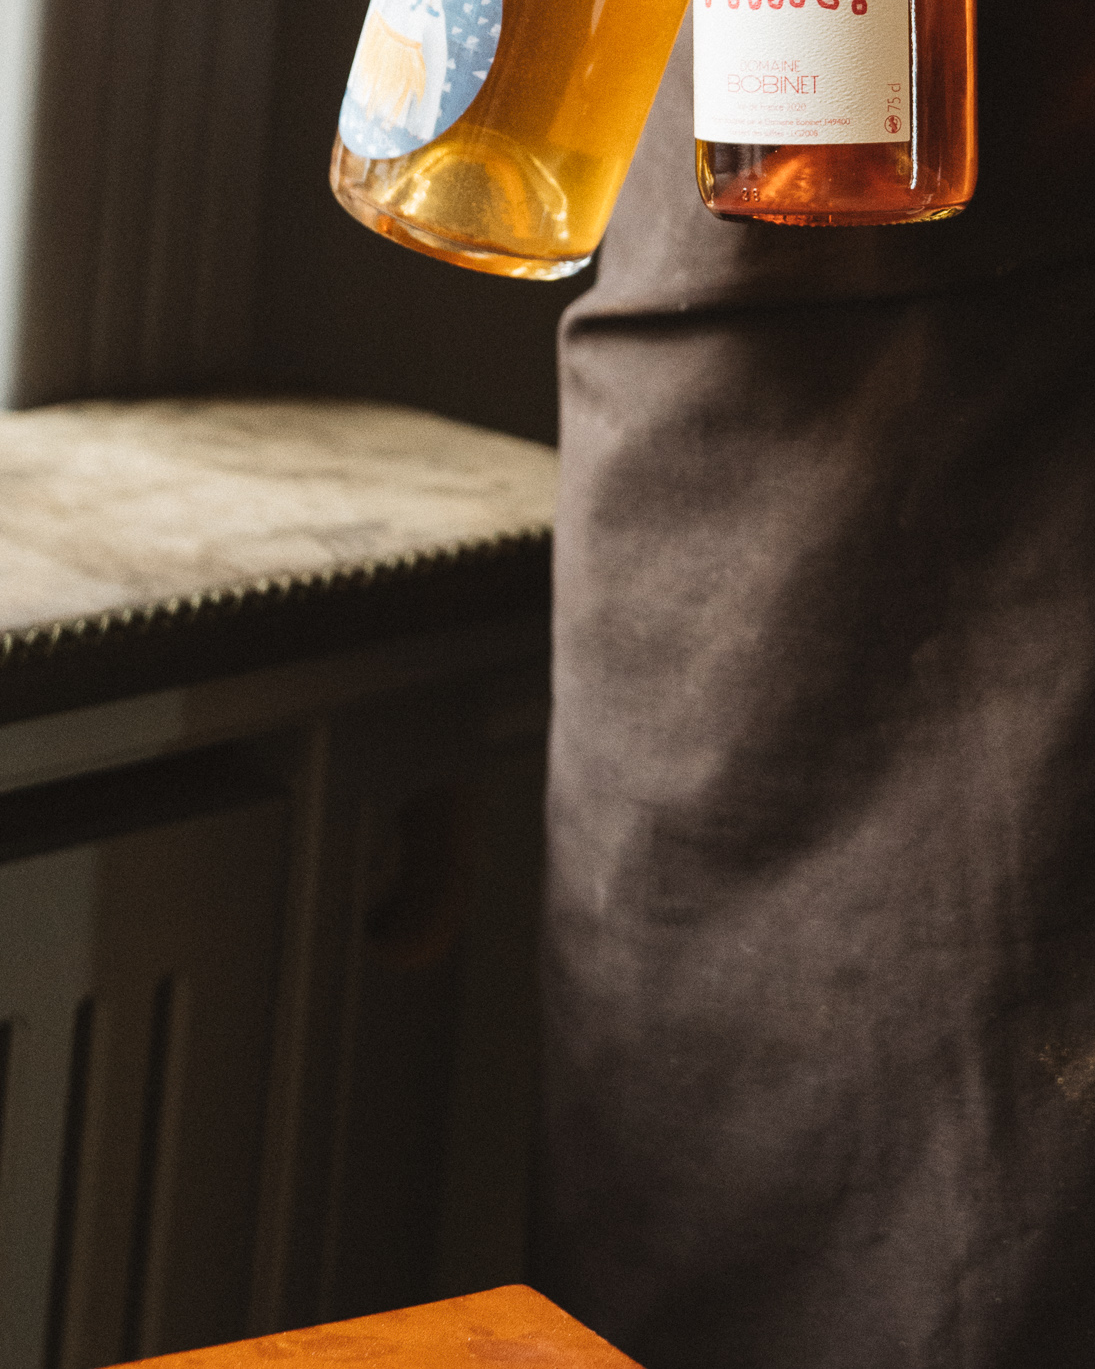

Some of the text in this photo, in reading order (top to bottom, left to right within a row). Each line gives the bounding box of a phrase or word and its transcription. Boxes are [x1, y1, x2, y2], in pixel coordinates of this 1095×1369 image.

[740, 59, 801, 73] DOMAINE
[727, 74, 819, 94] BOBINET
[887, 97, 901, 112] 75
